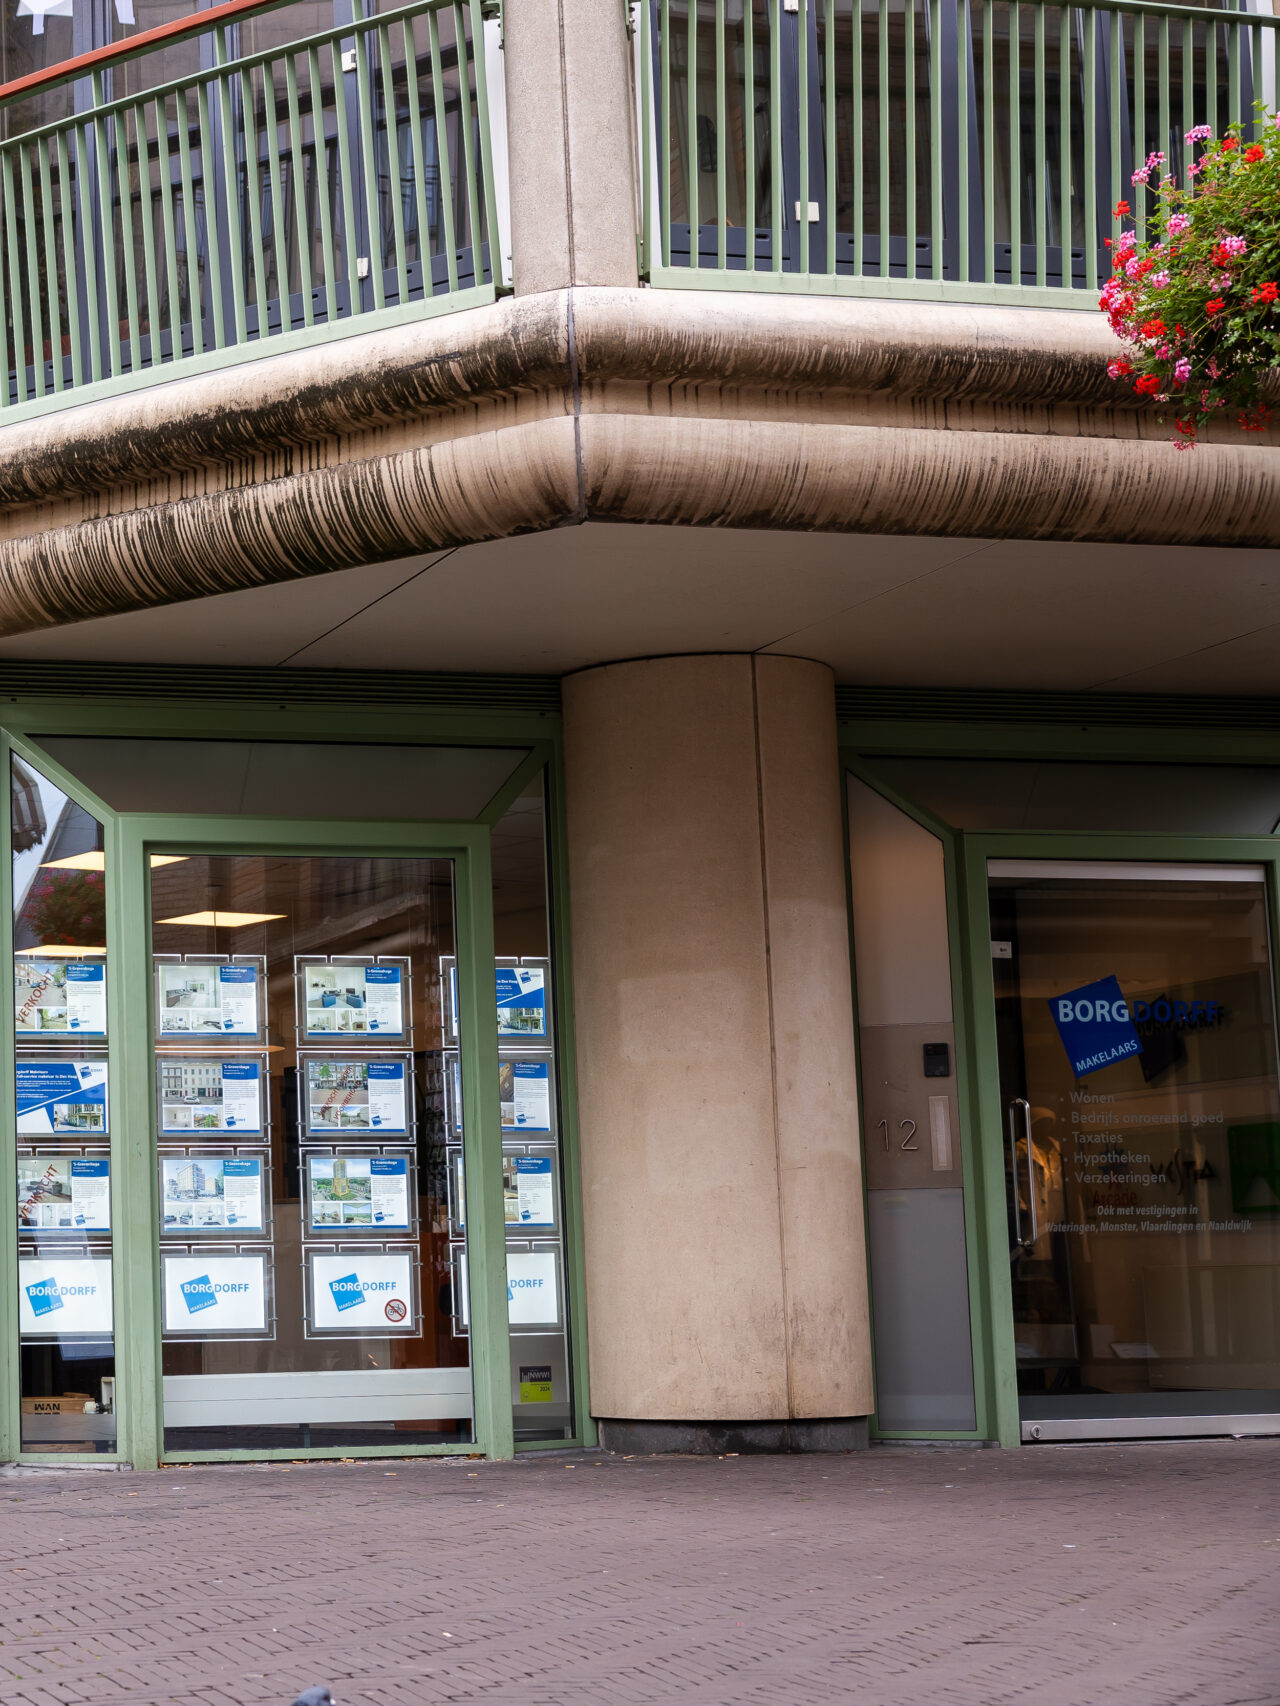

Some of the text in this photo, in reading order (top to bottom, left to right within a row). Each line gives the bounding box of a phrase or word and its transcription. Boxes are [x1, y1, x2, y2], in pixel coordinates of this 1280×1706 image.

[1058, 999, 1219, 1023] BORGDORFF
[1075, 1039, 1139, 1072] MAKELAARS
[1069, 1091, 1114, 1104] Wonen
[1071, 1112, 1224, 1127] Bedrijfs onroerend goed
[878, 1119, 919, 1152] 12
[1072, 1131, 1123, 1144] Taxaties
[1073, 1151, 1151, 1168] Hypotheken
[1074, 1170, 1166, 1187] Verzekeringen
[1116, 1206, 1134, 1216] met
[1135, 1204, 1188, 1218] vestigingen
[1188, 1204, 1198, 1215] in
[1100, 1222, 1138, 1234] Monster,
[1140, 1220, 1194, 1234] Vlaardingen
[1195, 1223, 1206, 1232] en
[1208, 1220, 1252, 1232] Naaldwijk
[184, 1284, 249, 1294] BORGDORFF
[332, 1282, 397, 1292] BORGDORFF
[510, 1279, 544, 1288] DORFF
[29, 1286, 96, 1296] BORGDORFF
